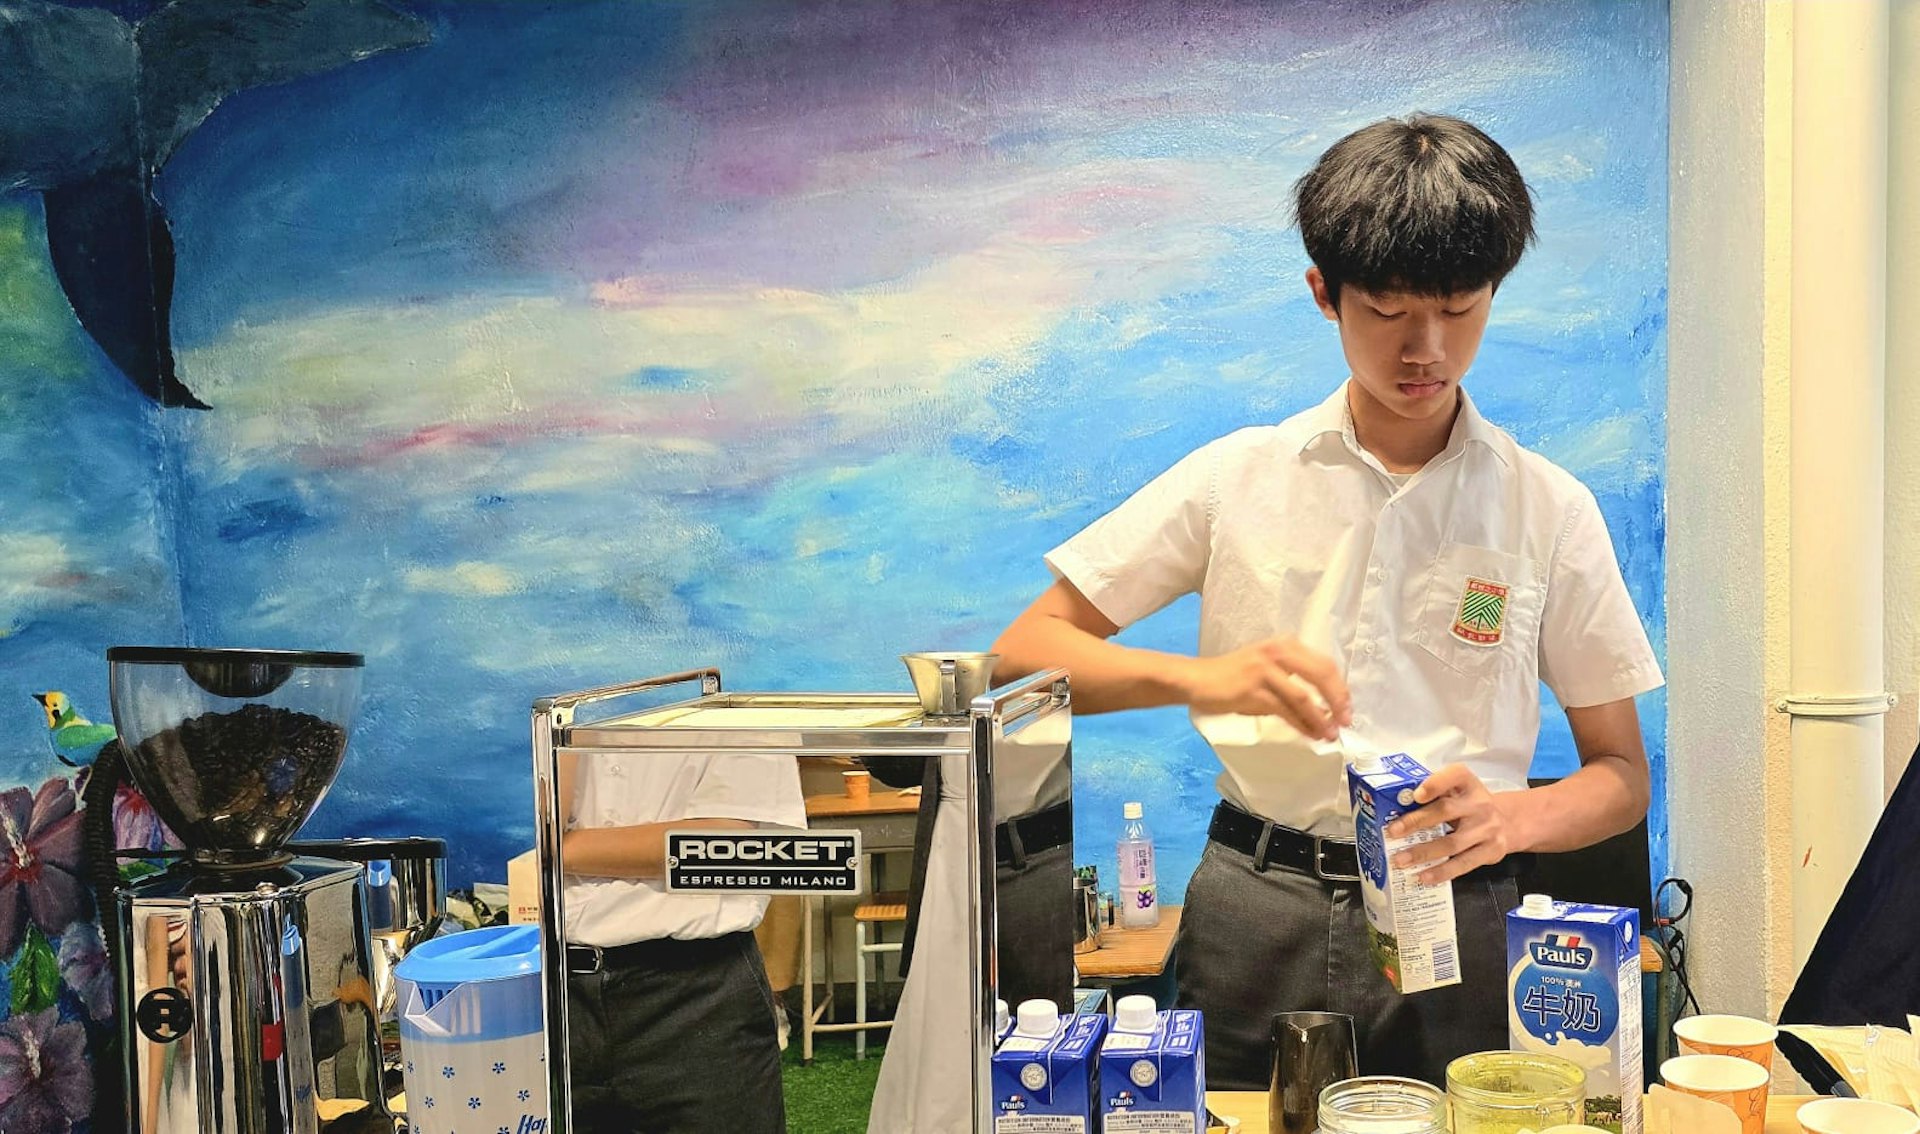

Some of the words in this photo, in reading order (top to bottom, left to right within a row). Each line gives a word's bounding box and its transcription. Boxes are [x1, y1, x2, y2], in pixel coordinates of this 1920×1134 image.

[679, 840, 846, 861] ROCKET
[680, 876, 771, 886] ESPRESSO
[781, 876, 847, 886] MILANO
[1537, 946, 1586, 965] Pauls
[1541, 976, 1564, 986] 100%
[1522, 985, 1601, 1032] 牛奶
